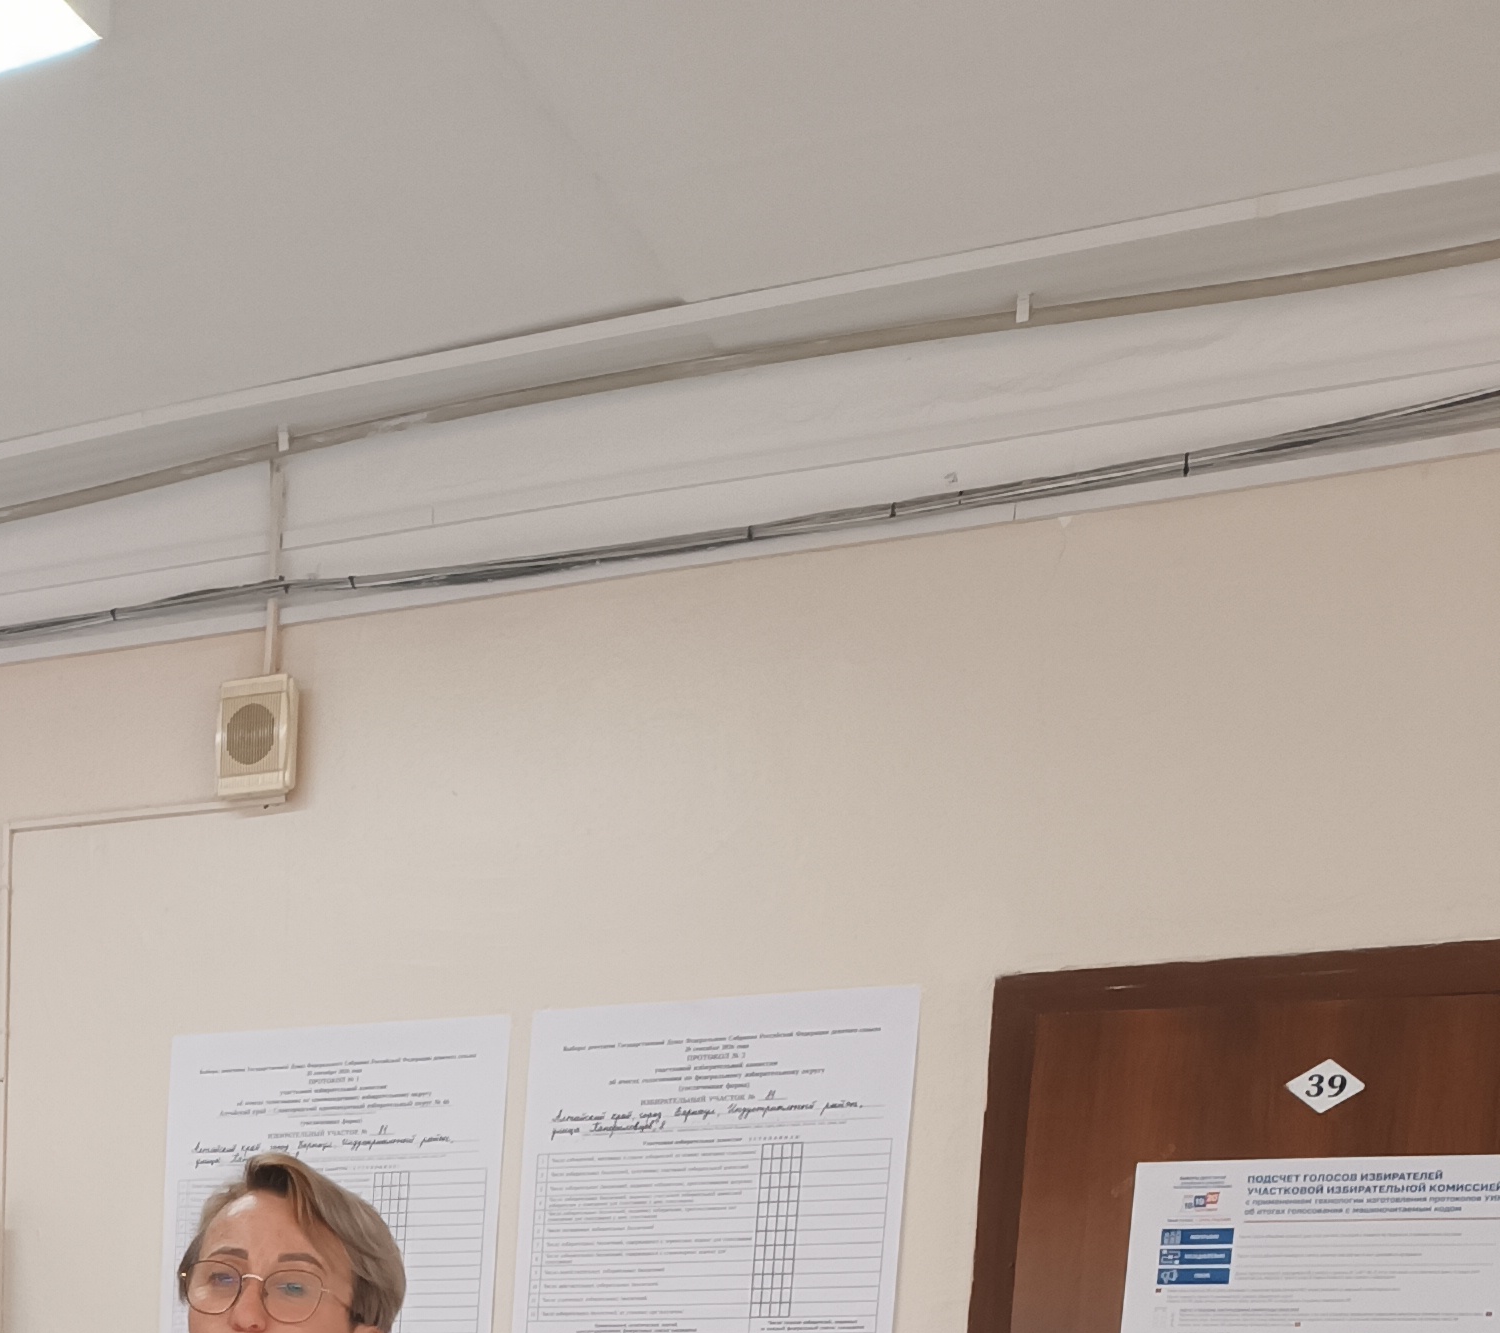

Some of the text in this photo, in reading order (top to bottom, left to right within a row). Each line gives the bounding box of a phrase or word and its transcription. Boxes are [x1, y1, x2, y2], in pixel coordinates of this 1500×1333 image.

[1305, 1073, 1347, 1098] 39
[708, 1093, 745, 1102] УЧАСТОК
[1247, 1169, 1444, 1184] ПОДСЧЕТ ГОЛОСОВ ИЗБИРАТЕЛЕЙ
[1247, 1184, 1324, 1195] УЧАСТКОВОЙ
[1326, 1182, 1426, 1194] ИЗБИРАТЕЛЬНОЙ
